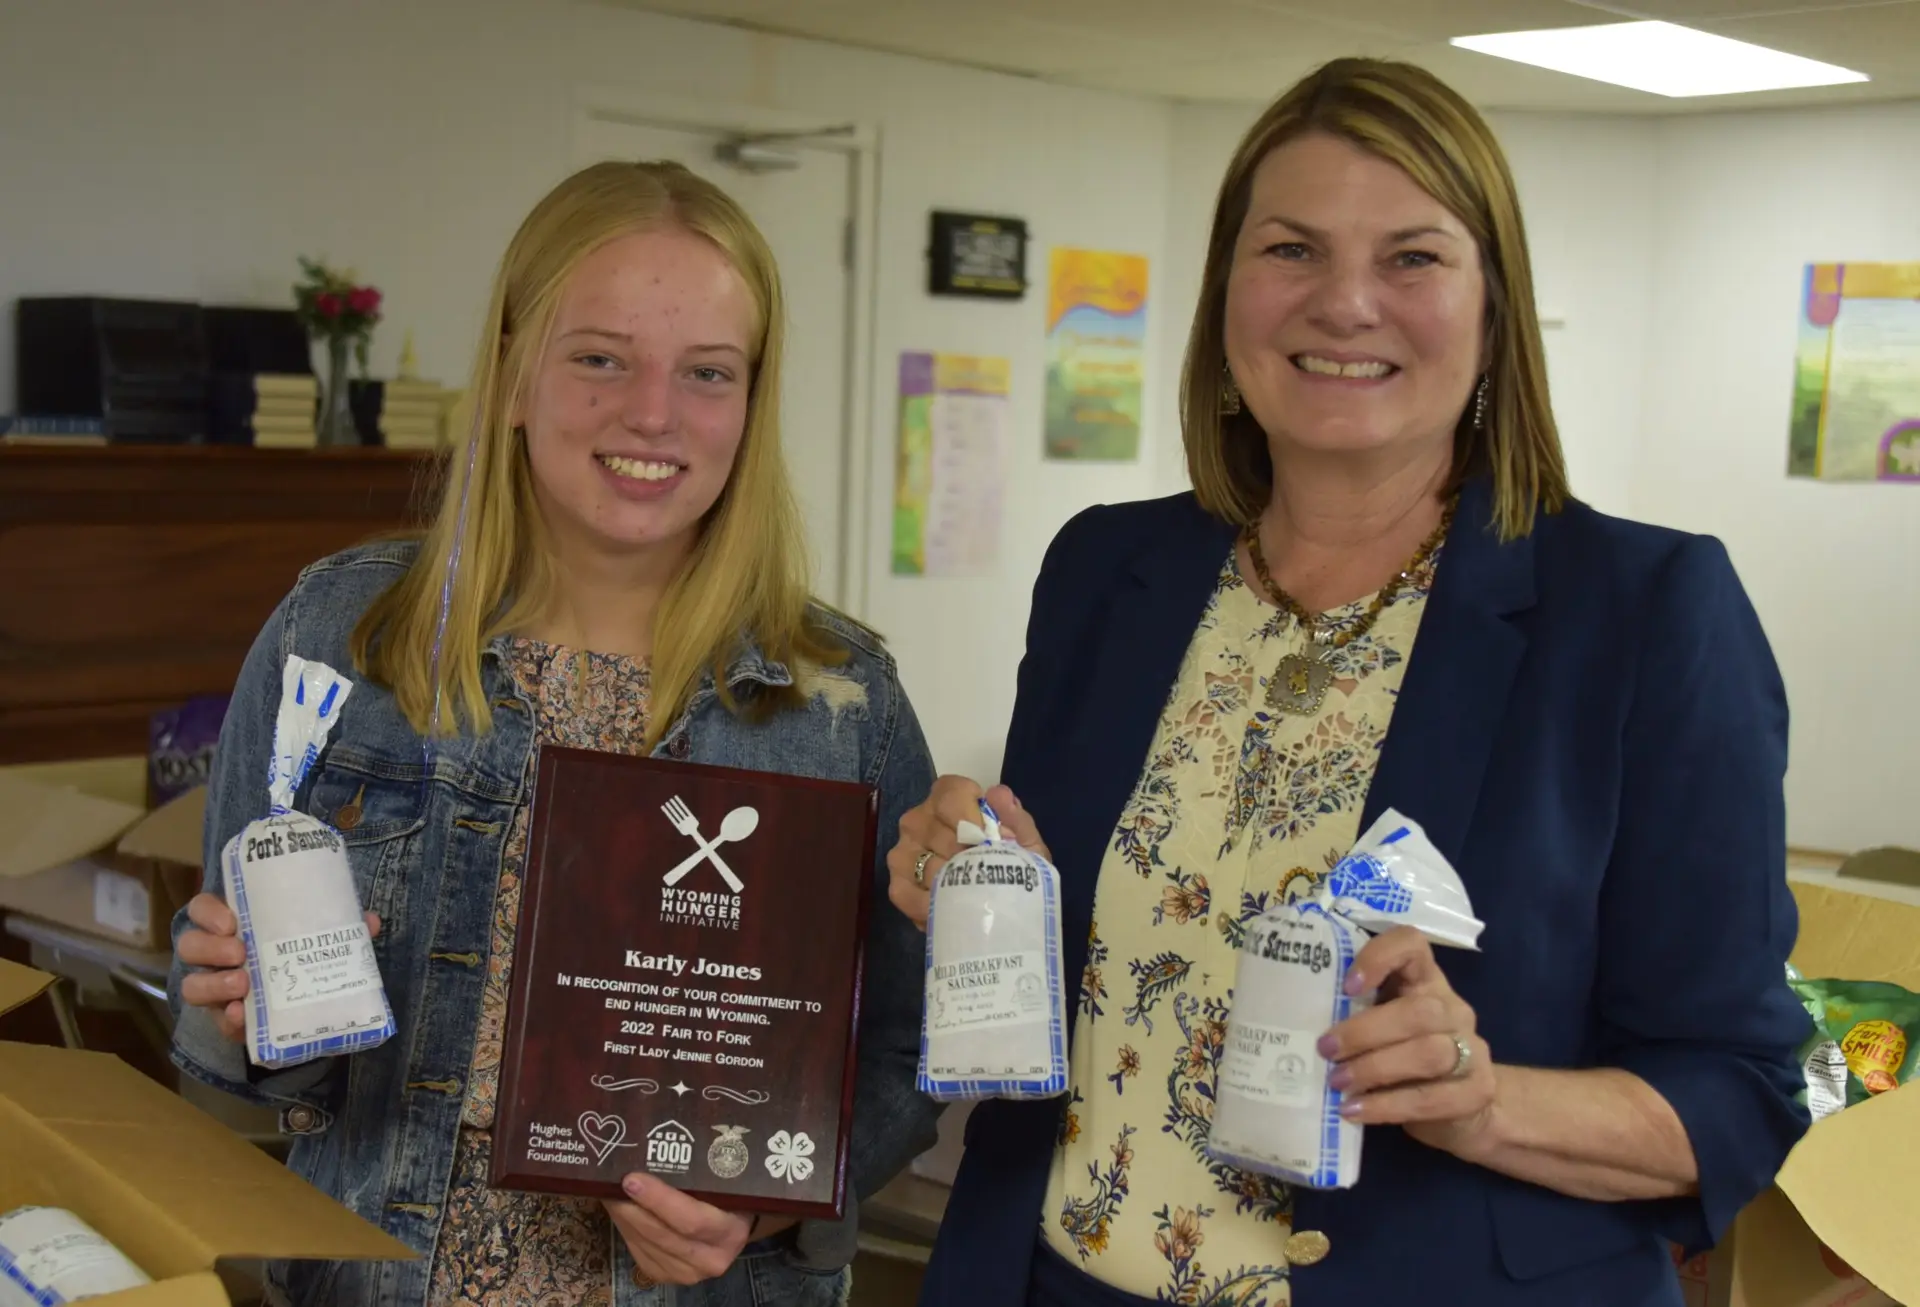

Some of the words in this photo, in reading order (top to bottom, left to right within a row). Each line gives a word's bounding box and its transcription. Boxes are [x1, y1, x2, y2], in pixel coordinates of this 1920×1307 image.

[246, 831, 285, 863] Pork
[975, 861, 1039, 892] Sausage
[661, 887, 741, 907] WYOMING
[661, 899, 741, 920] HUNGER
[659, 912, 740, 931] INITIATIVE
[276, 936, 314, 956] MILD
[316, 927, 365, 949] ITALIAN
[1262, 930, 1332, 974] Sausage
[297, 944, 353, 967] SAUSAGE
[624, 950, 688, 977] Karly
[691, 958, 762, 981] Jones
[958, 955, 1025, 977] BREAKFAST
[557, 973, 571, 986] IN
[574, 976, 659, 997] RECOGNITION
[662, 986, 680, 998] OF
[684, 988, 718, 1003] YOUR
[720, 992, 802, 1011] COMMITMENT
[805, 1000, 822, 1014] TO
[947, 973, 1001, 992] SAUSAGE
[604, 998, 631, 1011] END
[634, 1001, 687, 1017] HUNGER
[689, 1007, 702, 1019] IN
[706, 1006, 771, 1026] WYOMING.
[620, 1020, 655, 1036] 2022
[662, 1024, 692, 1040] FAIR
[695, 1029, 713, 1042] TO
[716, 1030, 752, 1046] FORK
[603, 1041, 637, 1056] FIRST
[639, 1044, 670, 1060] LADY
[672, 1048, 713, 1064] JENNIE
[715, 1052, 764, 1069] GORDON
[1842, 1040, 1901, 1066] SMILES
[529, 1122, 573, 1138] Hughes
[526, 1148, 589, 1165] Foundation
[528, 1136, 586, 1152] Charitable
[646, 1139, 692, 1165] FOOD
